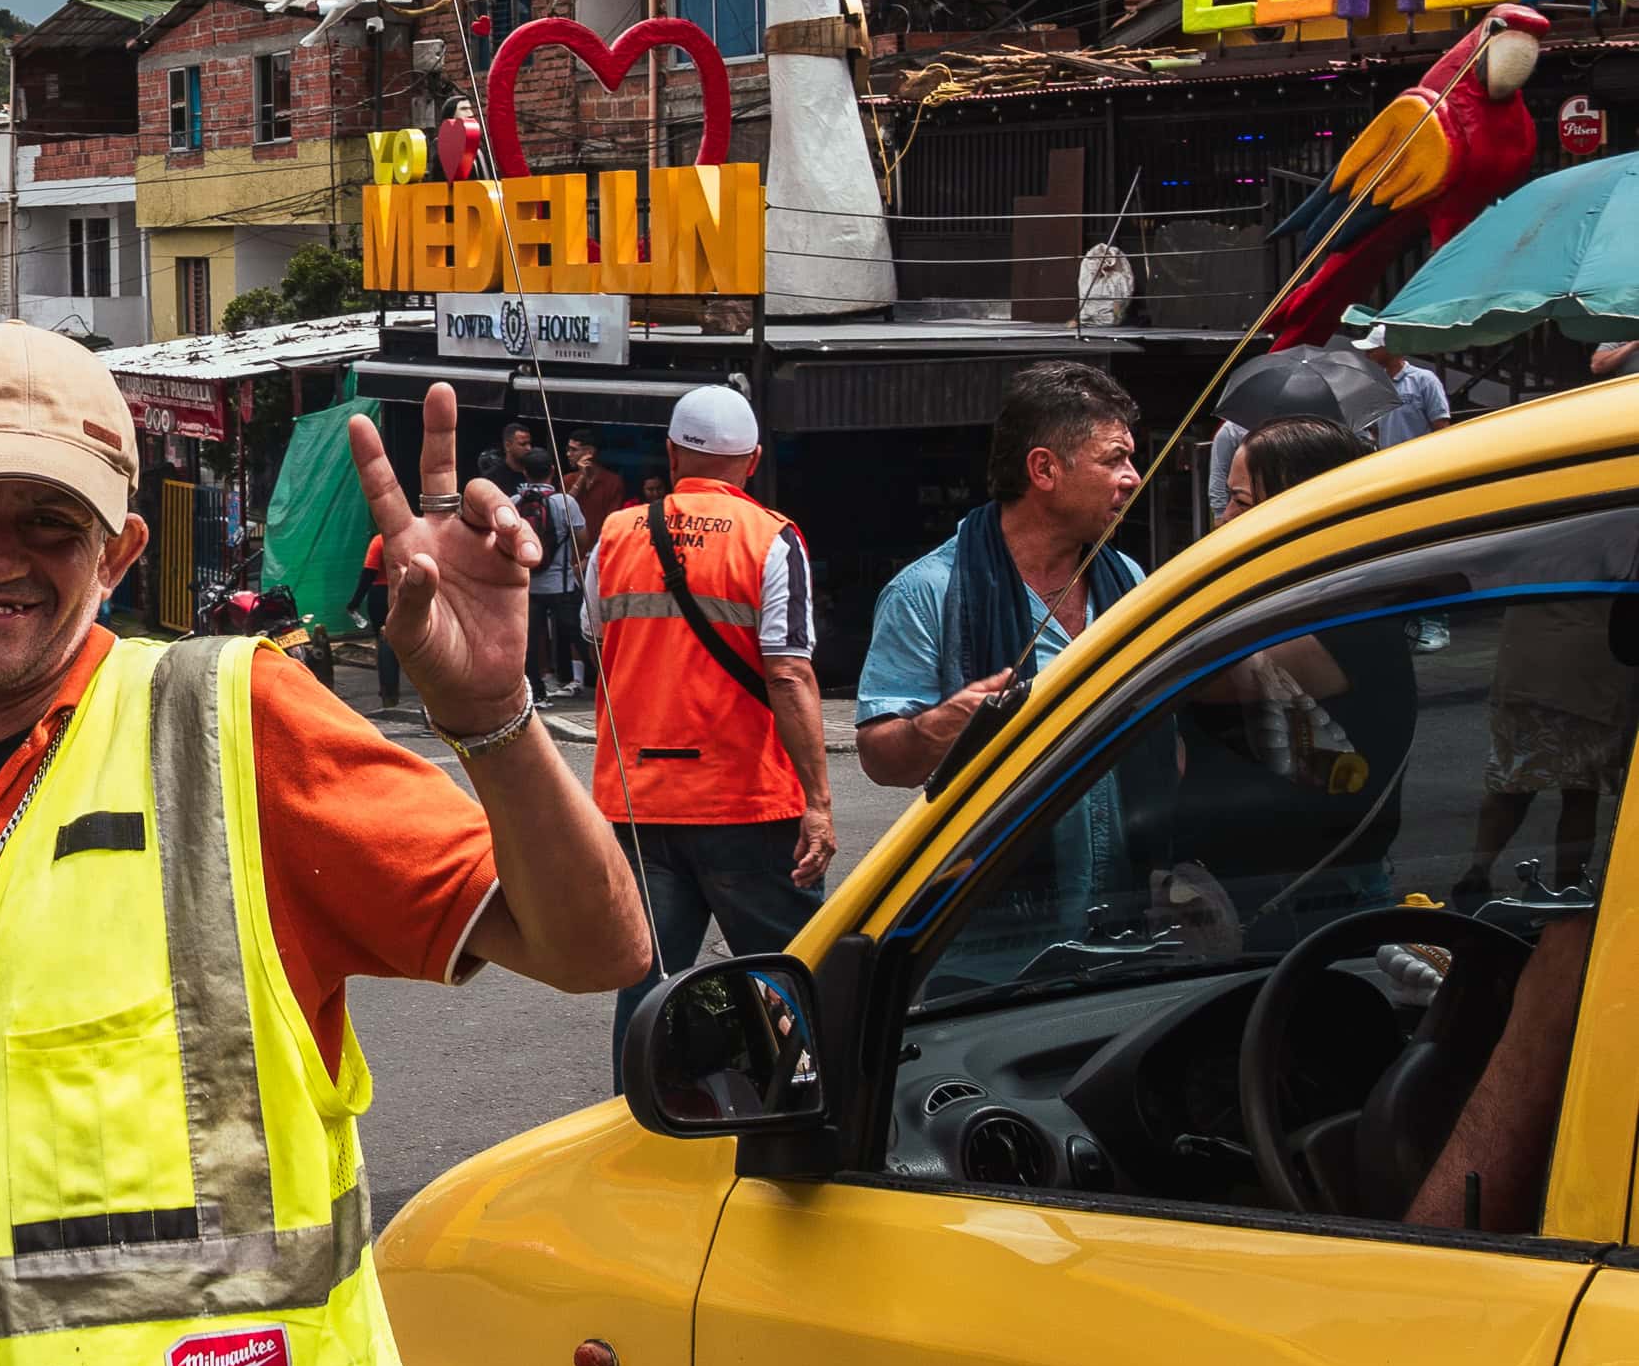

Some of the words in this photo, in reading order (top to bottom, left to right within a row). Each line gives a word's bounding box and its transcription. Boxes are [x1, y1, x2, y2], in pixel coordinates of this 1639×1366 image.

[1563, 122, 1598, 136] Pilsen
[367, 129, 427, 184] YO
[446, 314, 495, 339] POWER
[538, 315, 590, 342] HOUSE
